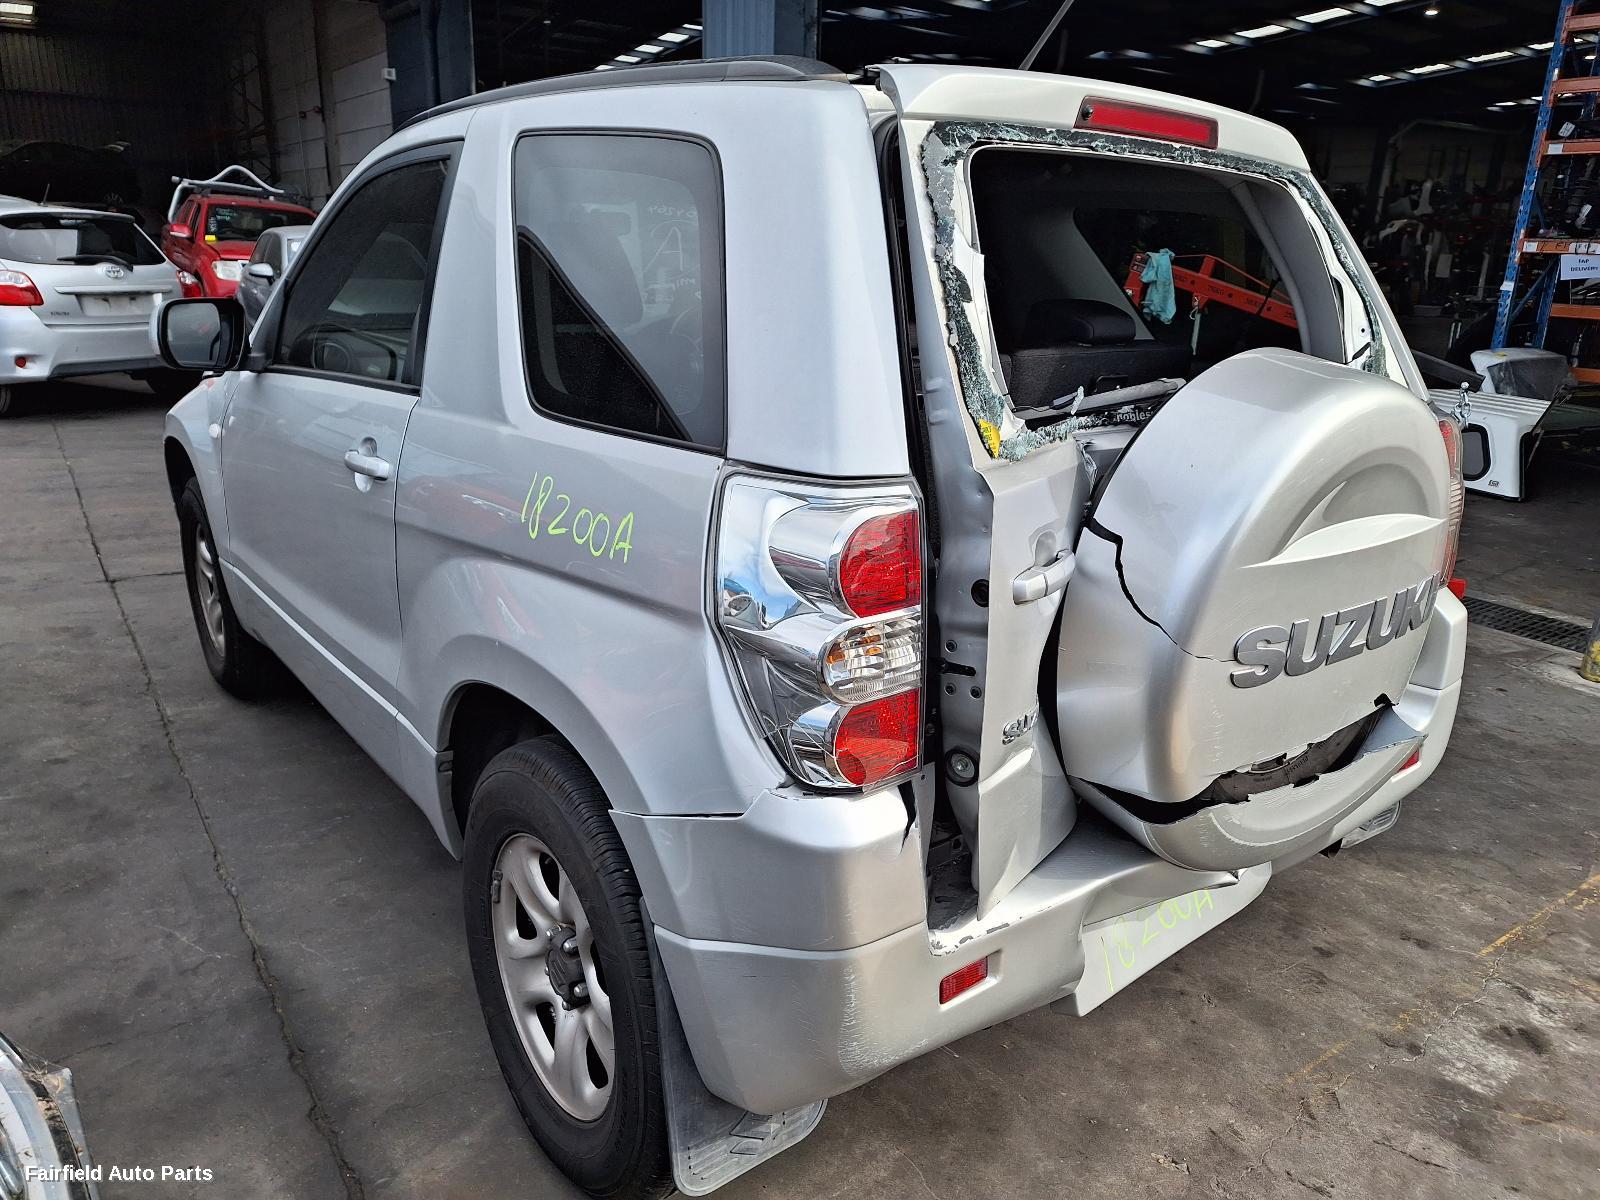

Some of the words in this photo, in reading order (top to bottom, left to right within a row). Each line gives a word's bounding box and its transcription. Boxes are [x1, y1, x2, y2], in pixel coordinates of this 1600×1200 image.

[1570, 265, 1600, 273] DELIVERY
[1116, 408, 1154, 422] nobles
[521, 471, 635, 564] 18200A
[1230, 570, 1440, 689] SUZUKI
[1100, 887, 1214, 993] 18200A
